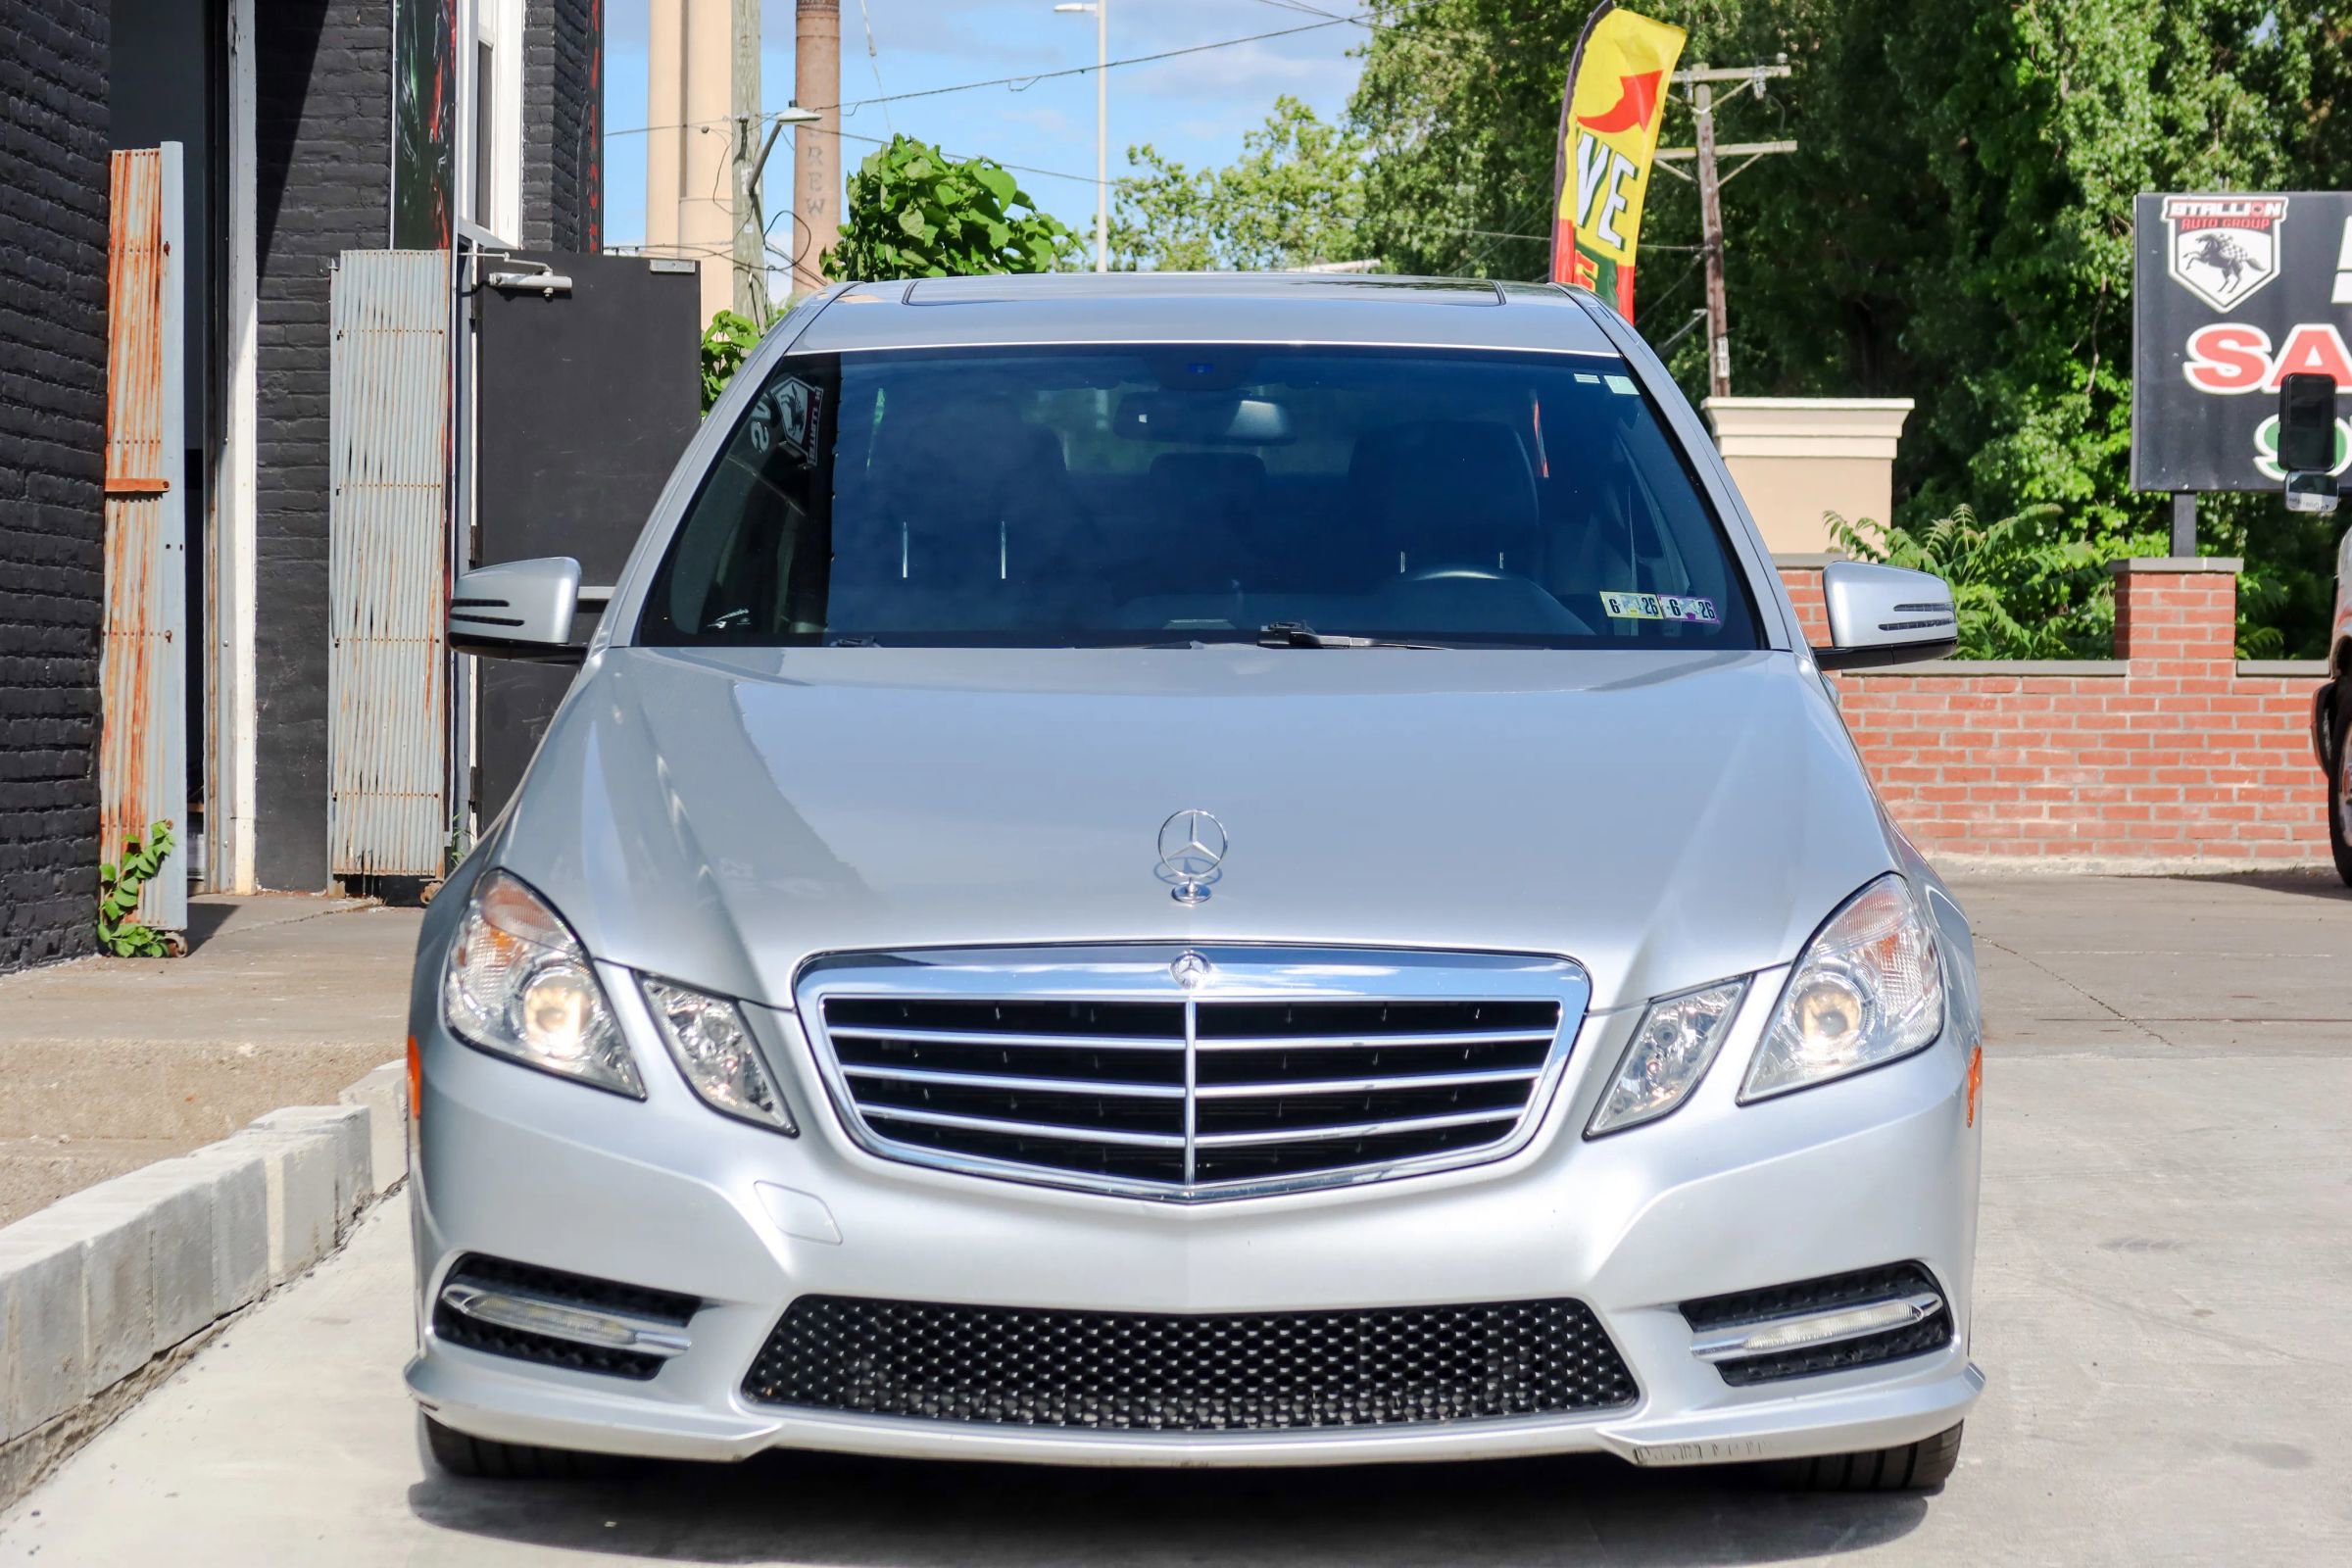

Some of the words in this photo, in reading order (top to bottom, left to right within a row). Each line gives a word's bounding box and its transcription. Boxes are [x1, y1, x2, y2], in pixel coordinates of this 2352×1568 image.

[1577, 131, 1640, 251] VE
[2170, 202, 2282, 216] STALLION
[2181, 218, 2218, 229] AUTO
[2223, 218, 2270, 228] GROUP
[1609, 599, 1620, 613] 6
[1642, 598, 1659, 614] 26
[1670, 599, 1682, 616] 6
[1698, 602, 1716, 618] 26
